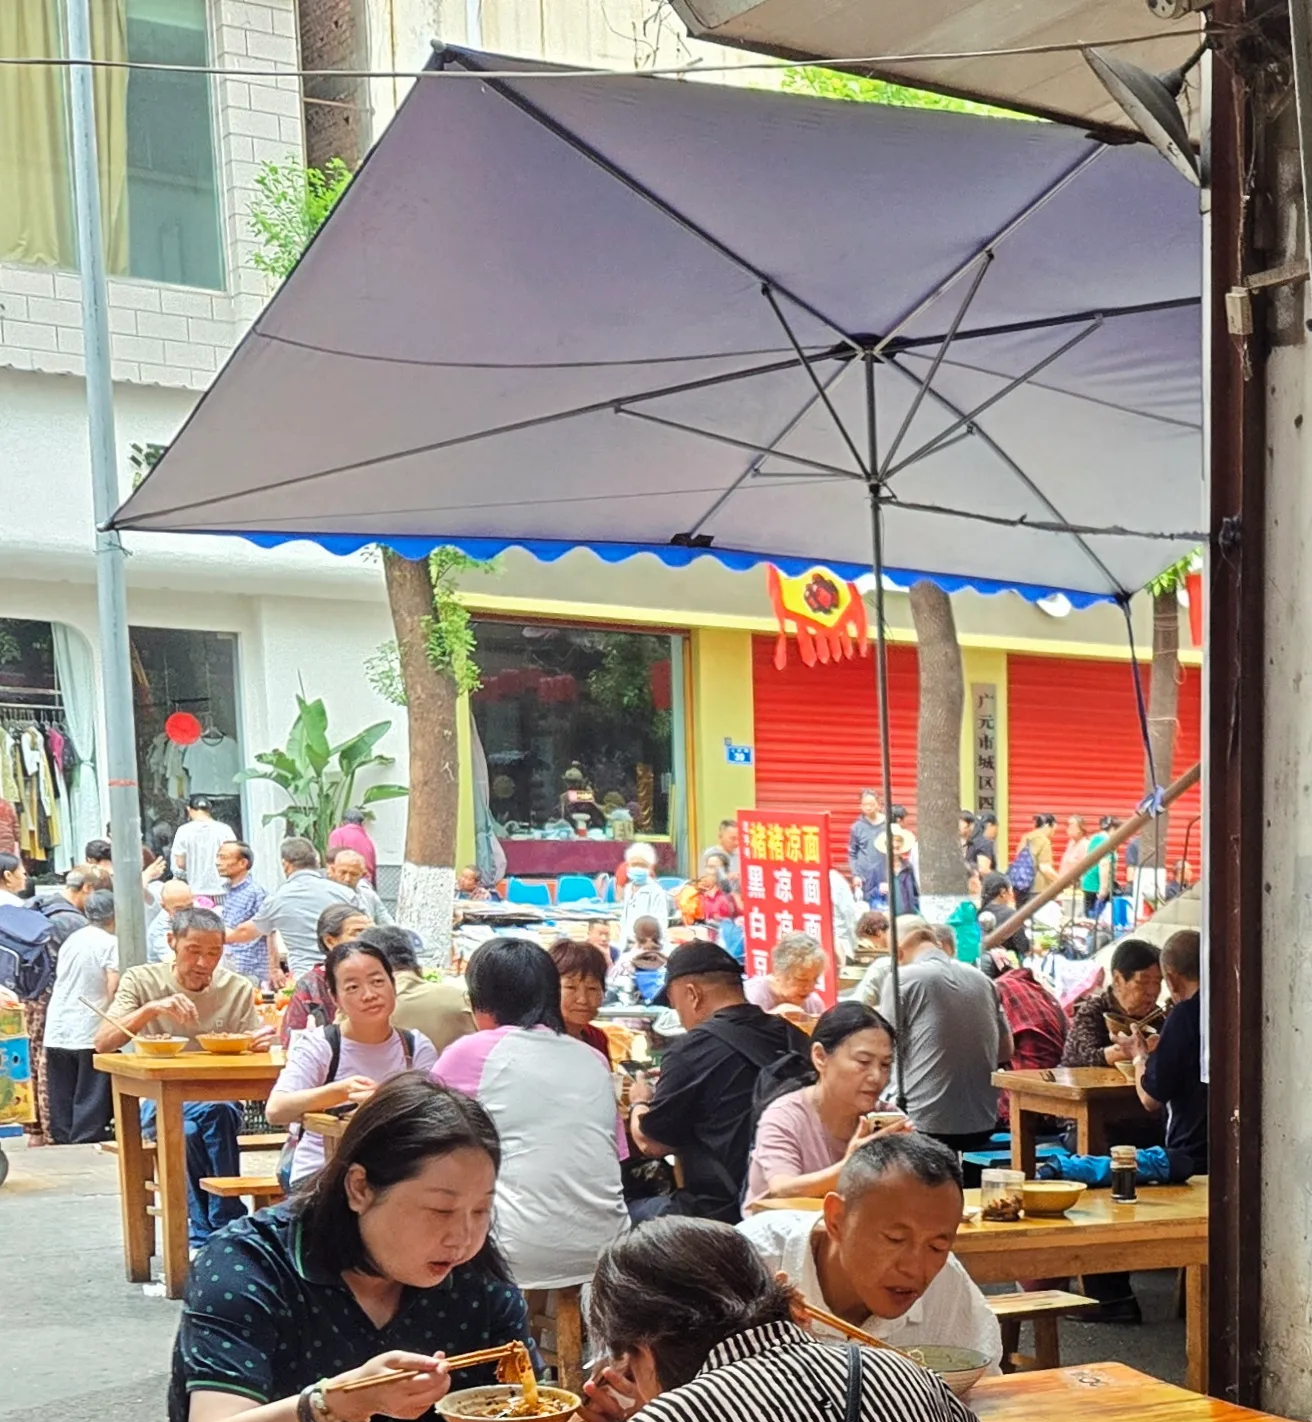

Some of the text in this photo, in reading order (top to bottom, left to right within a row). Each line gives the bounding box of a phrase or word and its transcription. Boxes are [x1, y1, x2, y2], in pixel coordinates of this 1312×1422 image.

[978, 693, 995, 810] 广元市城区四
[747, 864, 821, 906] 黑凉面
